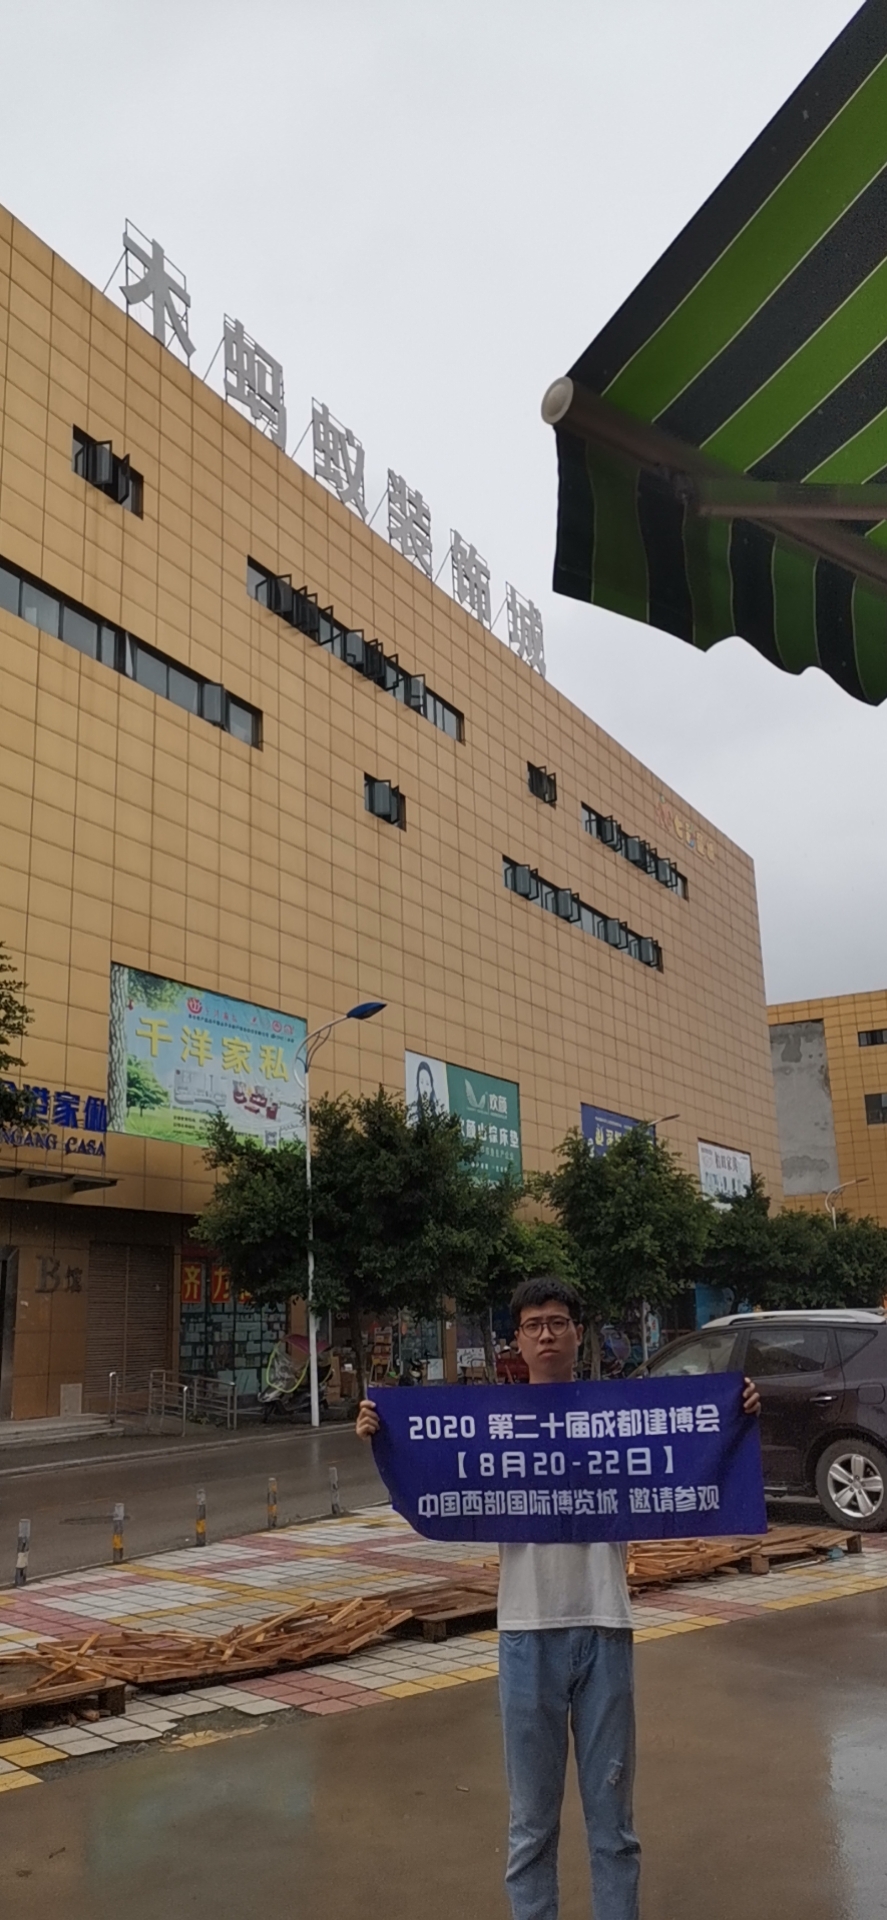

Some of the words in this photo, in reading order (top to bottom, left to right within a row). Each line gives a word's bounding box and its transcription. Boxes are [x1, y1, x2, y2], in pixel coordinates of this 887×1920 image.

[119, 232, 546, 677] 木蚂蚁装饰城
[65, 1136, 106, 1157] CASA
[409, 1415, 476, 1440] 2020
[488, 1403, 721, 1440] 第二十届成都建博会
[418, 1488, 619, 1518] 中国西部国际博览城
[628, 1484, 721, 1515] 邀请参观
